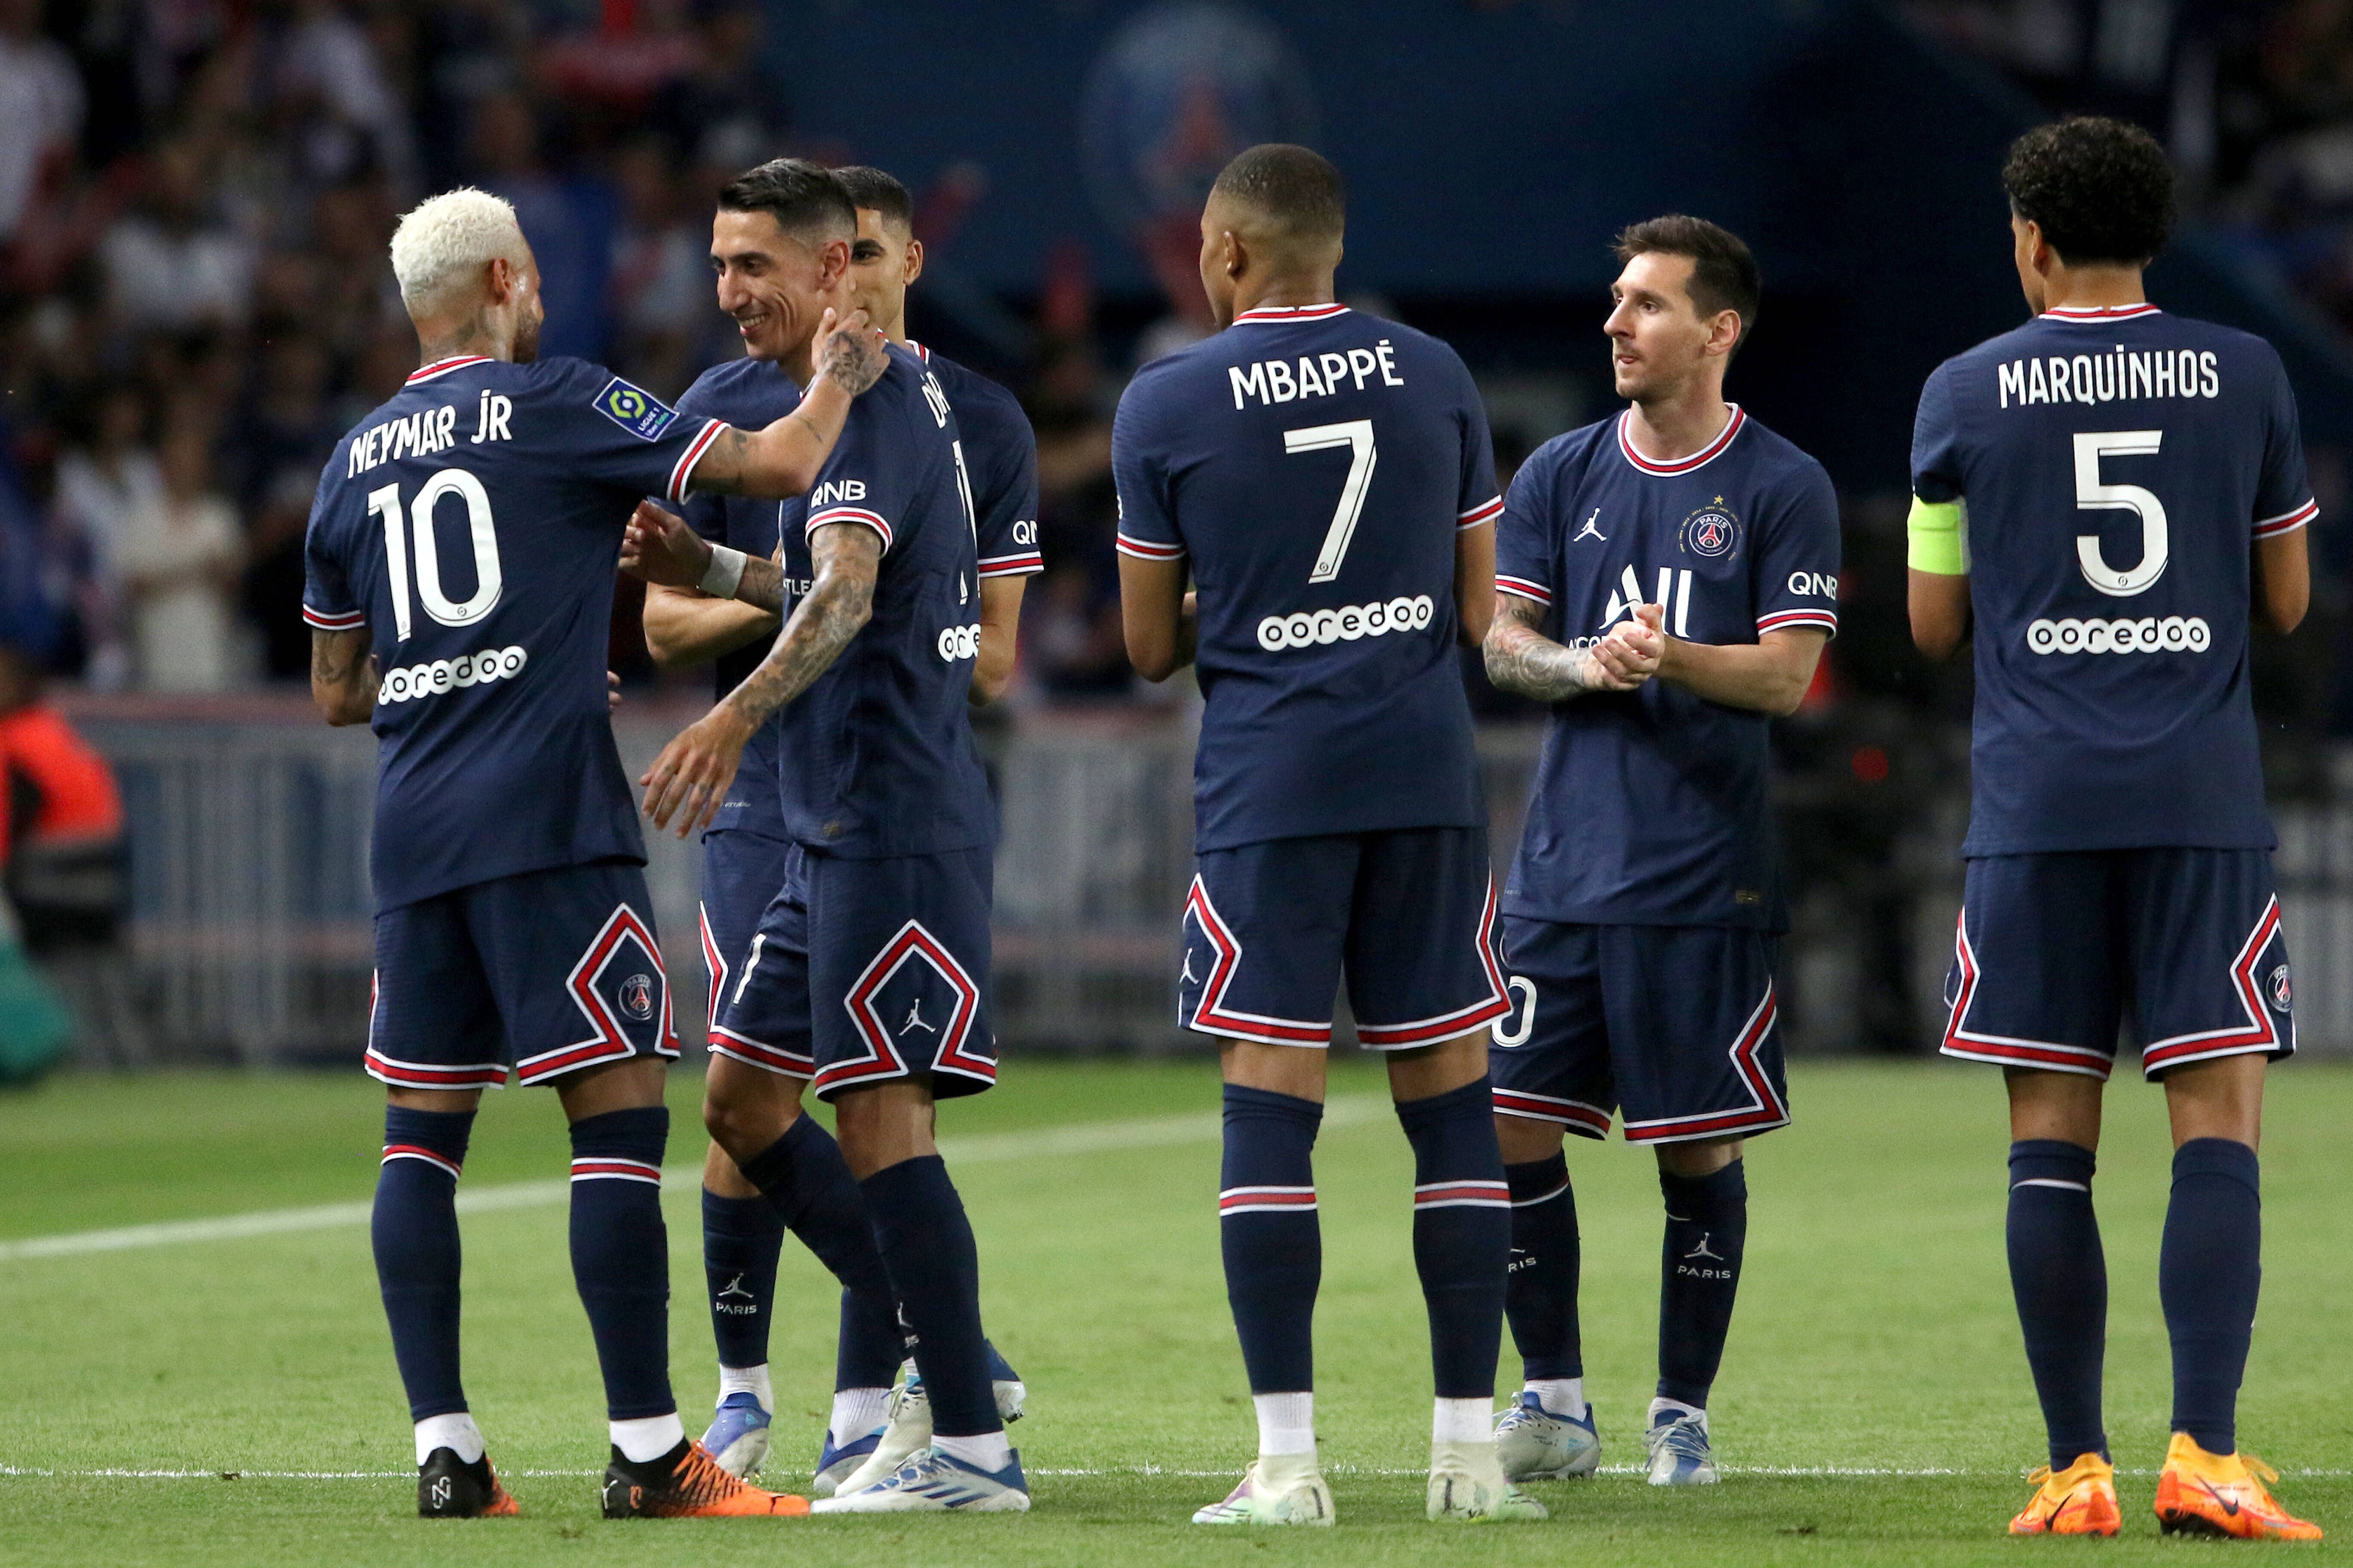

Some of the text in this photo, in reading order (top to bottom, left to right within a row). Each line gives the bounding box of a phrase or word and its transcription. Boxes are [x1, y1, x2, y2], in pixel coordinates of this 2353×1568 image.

[1228, 339, 1404, 410] MBAPPÉ
[347, 405, 456, 478] NEYMAR
[811, 480, 866, 508] QNB
[1283, 420, 1377, 584] 7
[2073, 430, 2168, 597] 5
[1699, 517, 1728, 529] PARIS
[367, 468, 503, 642] 10
[1788, 571, 1838, 601] QNB
[1258, 596, 1433, 651] ooredoo
[2028, 616, 2211, 654] ooredoo
[1678, 1265, 1731, 1279] PARIS
[716, 1302, 757, 1315] PARIS
